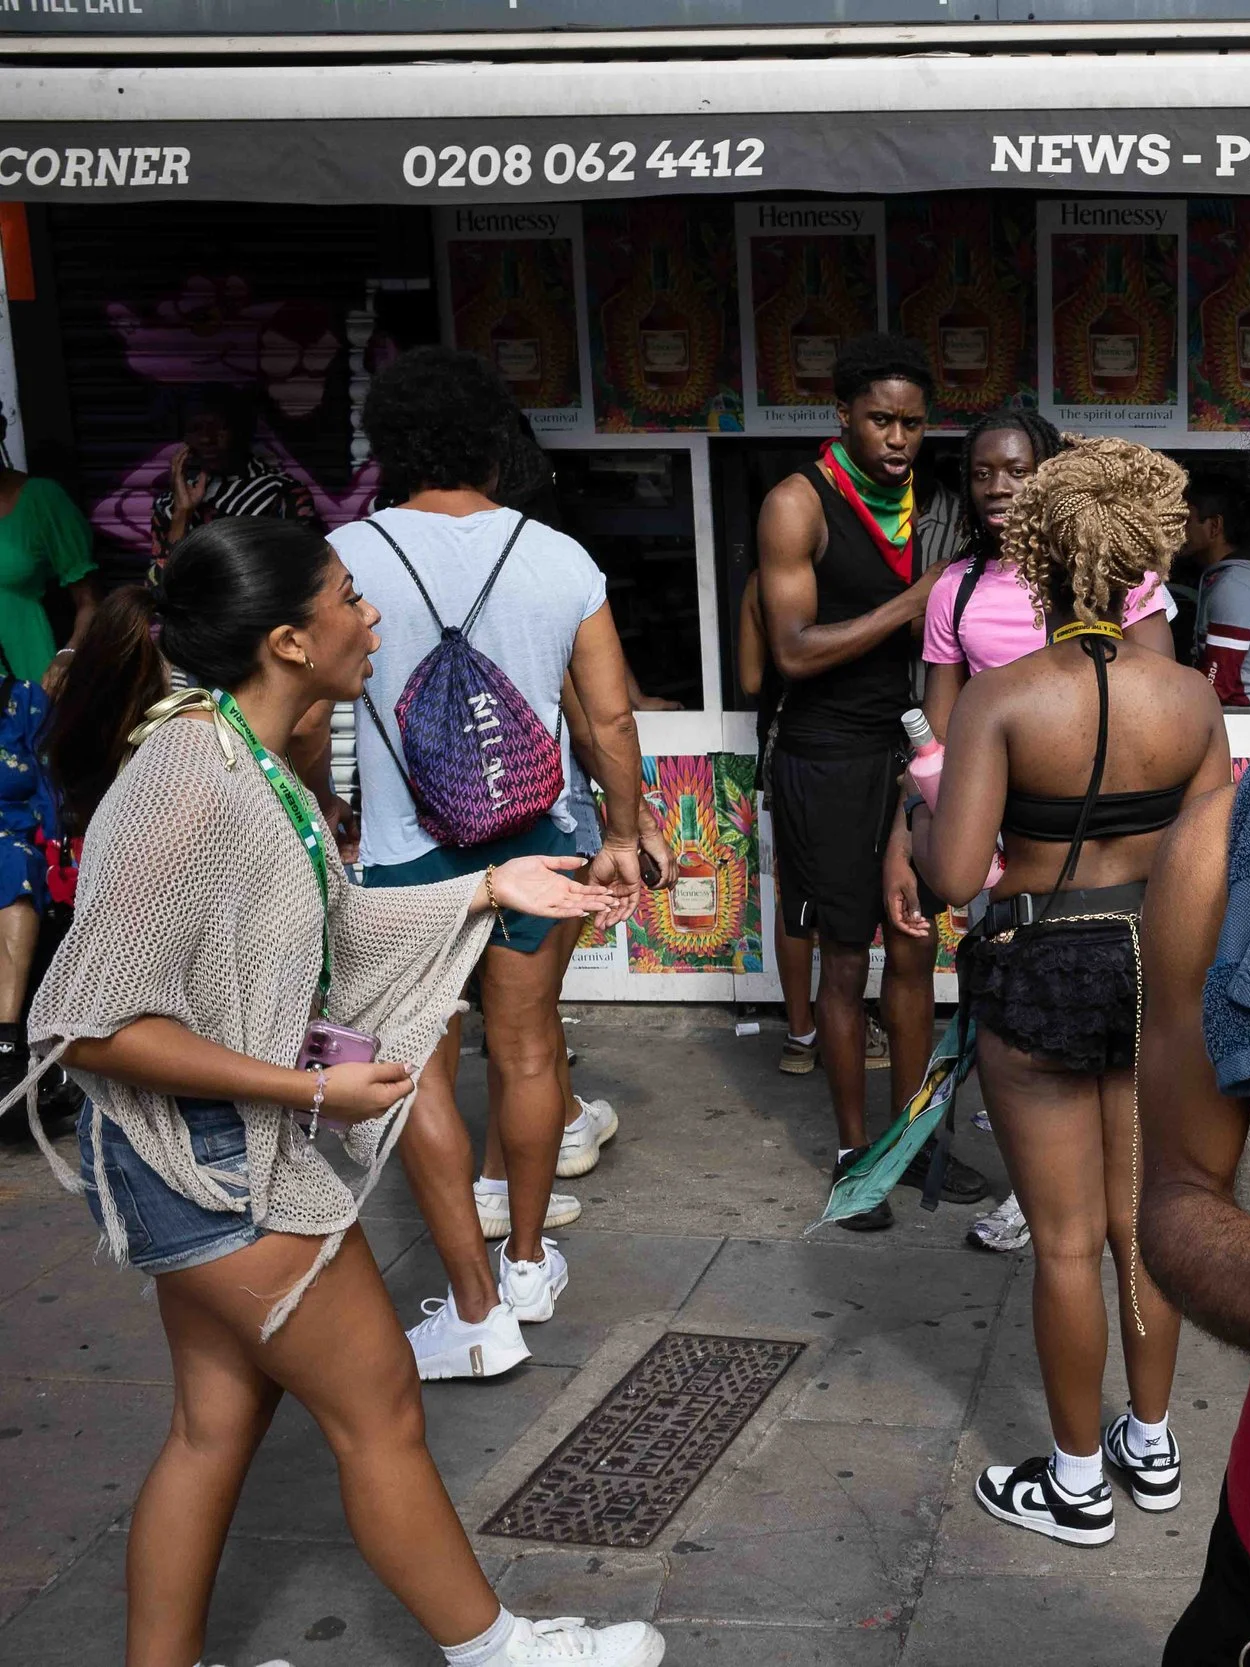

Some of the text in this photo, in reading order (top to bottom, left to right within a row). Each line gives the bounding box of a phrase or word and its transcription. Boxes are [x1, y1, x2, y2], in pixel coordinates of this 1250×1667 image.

[0, 146, 191, 187] CORNER
[402, 137, 765, 187] 0208 062 4412
[990, 133, 1171, 176] NEWS
[455, 209, 560, 235] Hennessy
[758, 205, 864, 231] Hennessy
[1061, 203, 1167, 230] Hennessy
[535, 412, 578, 423] carnival
[764, 410, 785, 422] The
[787, 410, 816, 425] spirit
[818, 410, 831, 422] of
[1059, 409, 1173, 423] The spirit of carnival
[229, 705, 258, 746] NIGERIA
[278, 781, 304, 823] NIGERIA
[571, 951, 614, 962] carnival
[618, 1412, 668, 1454] FIRE
[630, 1396, 713, 1474] HYDRANT
[1152, 1456, 1171, 1467] NIKE
